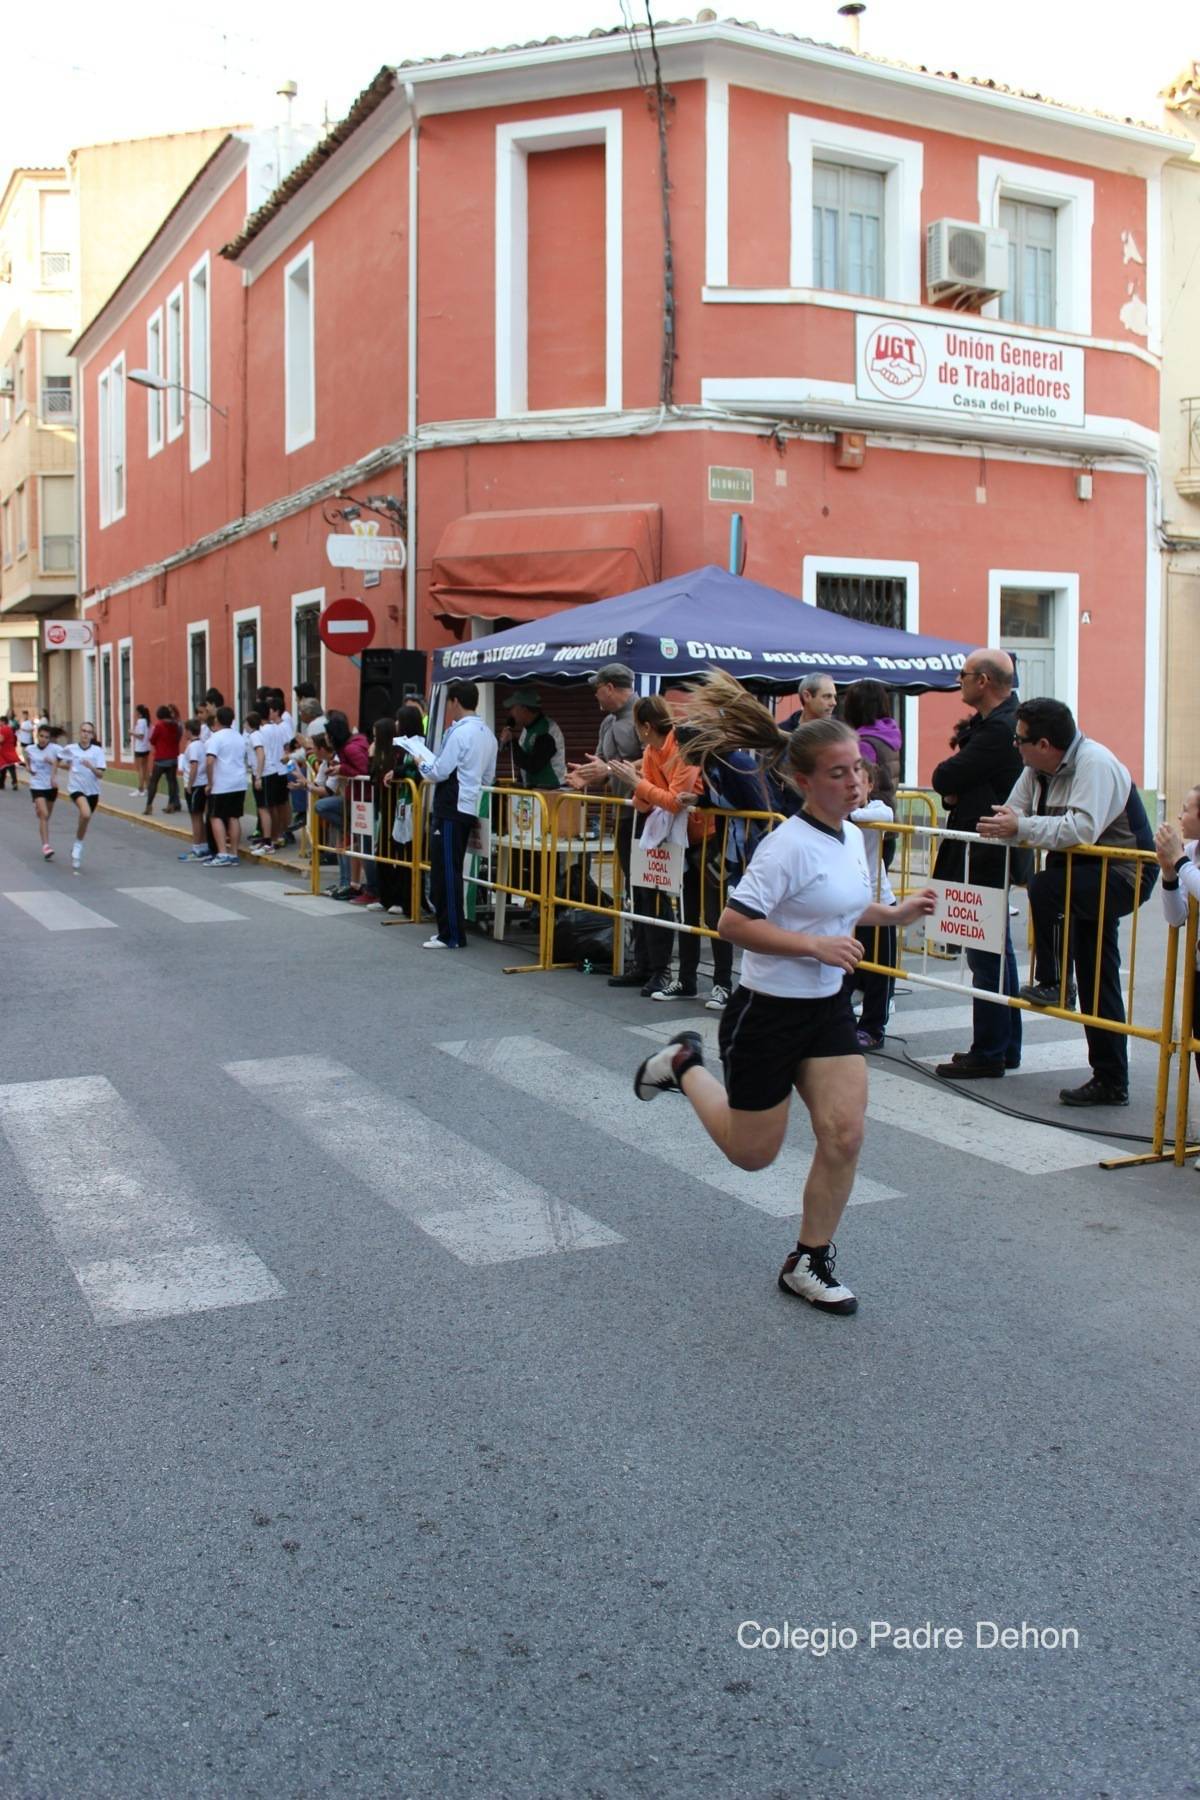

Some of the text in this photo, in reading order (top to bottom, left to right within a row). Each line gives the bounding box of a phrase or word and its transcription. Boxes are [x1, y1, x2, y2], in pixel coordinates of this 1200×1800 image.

[875, 334, 916, 364] UGT
[946, 333, 1064, 372] Unión General
[938, 361, 1070, 400] de Trabajadores
[953, 393, 1057, 419] Casa del Pueblo
[686, 640, 753, 661] Club
[646, 848, 672, 861] POLICIA
[648, 860, 668, 874] LOCAL
[642, 872, 672, 888] NOVELDA
[945, 888, 983, 906] POLICIA
[947, 905, 979, 922] LOCAL
[940, 920, 985, 940] NOVELDA
